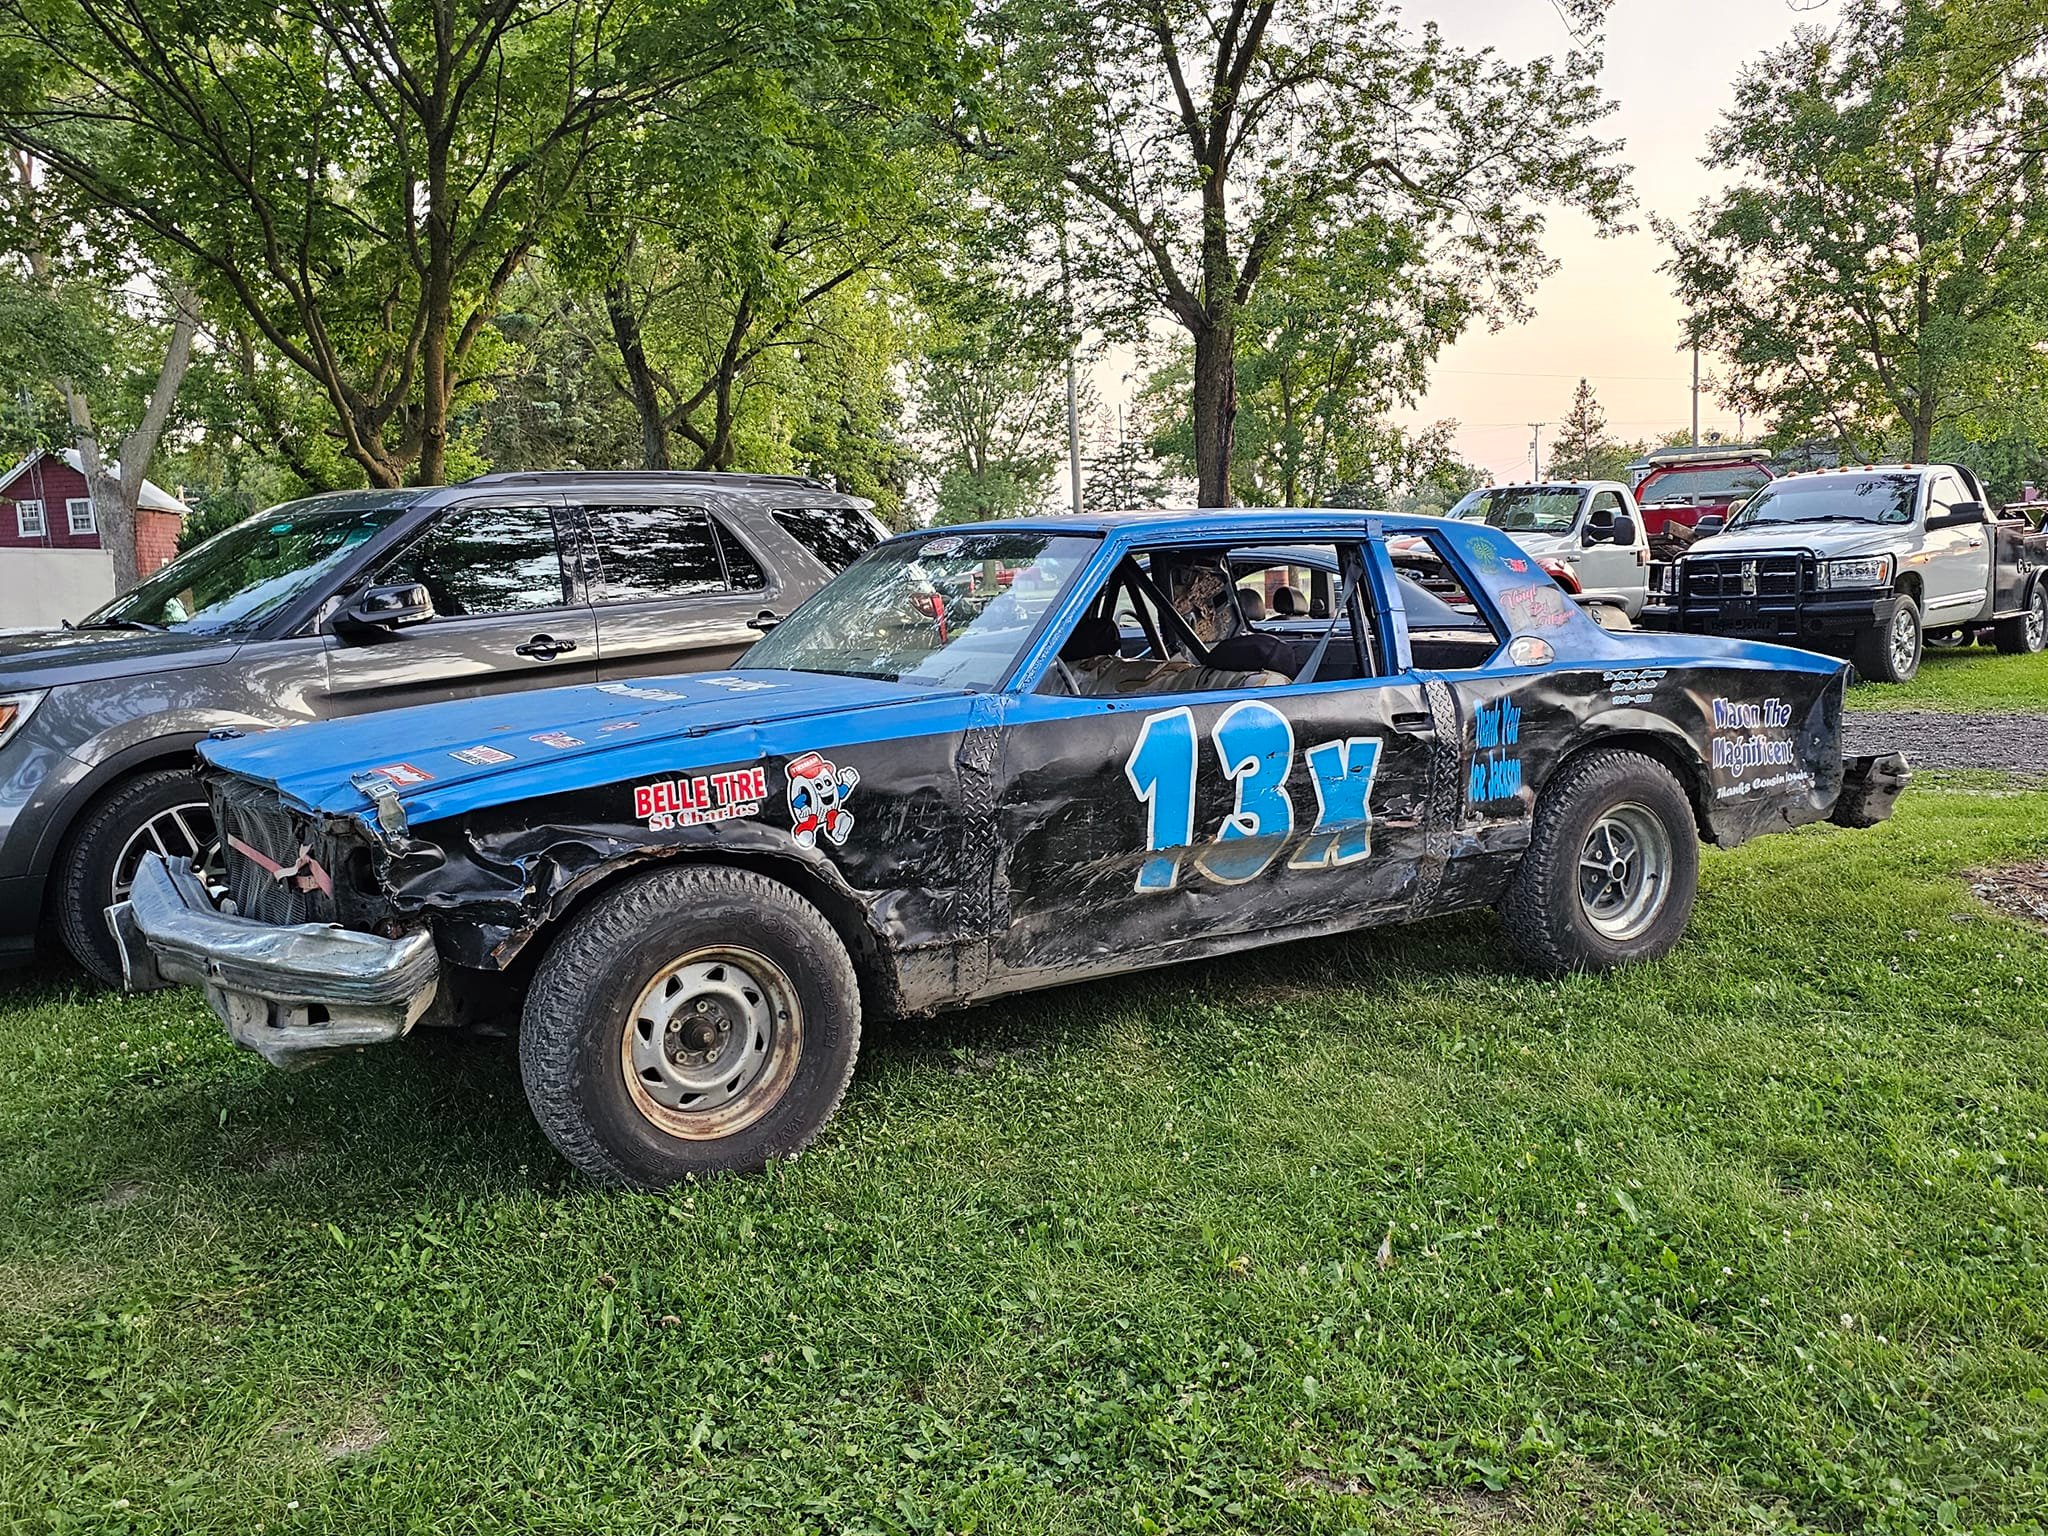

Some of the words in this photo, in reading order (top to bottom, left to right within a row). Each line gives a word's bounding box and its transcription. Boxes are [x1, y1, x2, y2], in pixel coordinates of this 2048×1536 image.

[1473, 696, 1501, 750] Thank
[1502, 695, 1522, 746] You
[1712, 697, 1762, 730] Mason
[1763, 697, 1793, 728] The
[1468, 752, 1487, 802] Joe
[1488, 747, 1523, 801] Jackson
[1711, 734, 1795, 778] Magnificent
[634, 777, 709, 819] BELLE
[711, 767, 768, 805] TIRE
[1716, 781, 1752, 800] Thanks
[1752, 772, 1785, 790] Cousin
[649, 813, 676, 832] St
[678, 802, 759, 828] Charles
